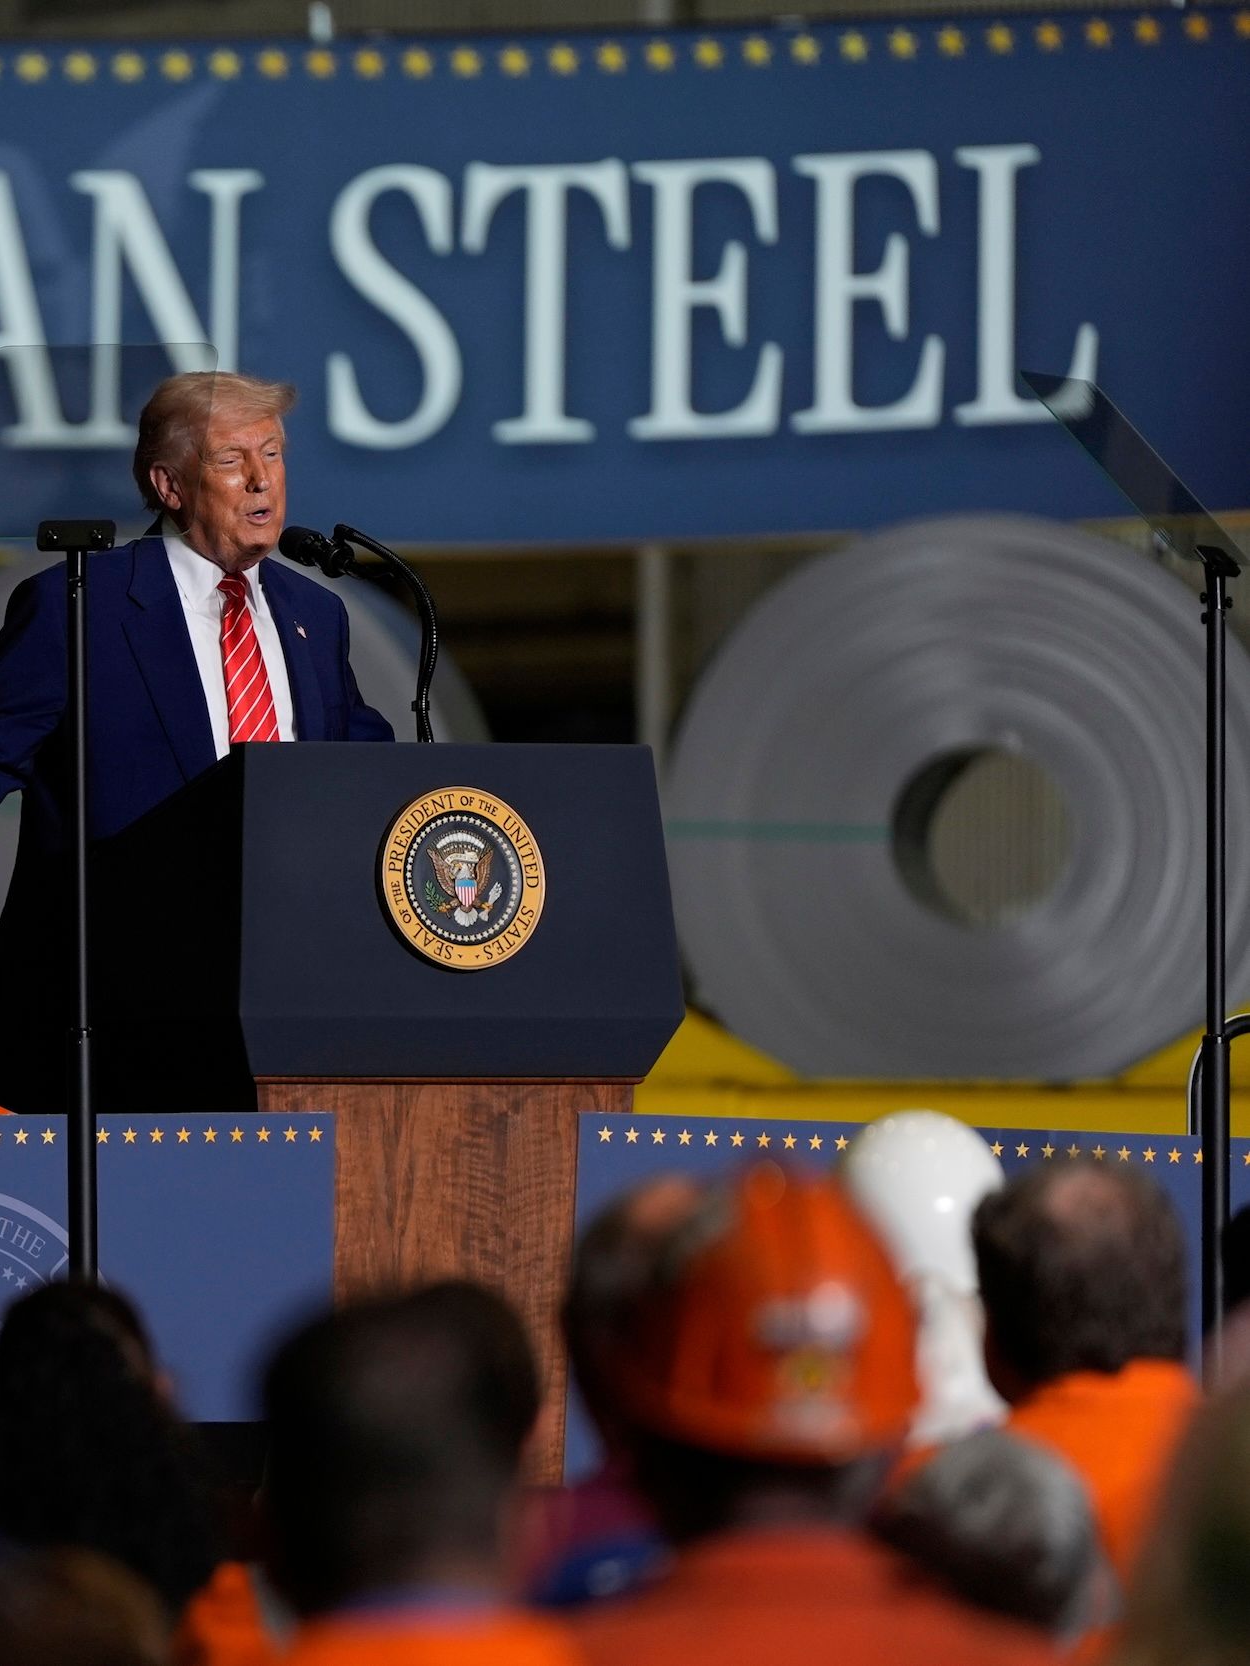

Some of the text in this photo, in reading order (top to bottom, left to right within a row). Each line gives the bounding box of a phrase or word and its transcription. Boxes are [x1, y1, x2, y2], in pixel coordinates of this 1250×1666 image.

[326, 143, 1099, 449] STEEL
[389, 793, 540, 960] SEAL OF THE PRESIDENT OF THE UNITED STATES
